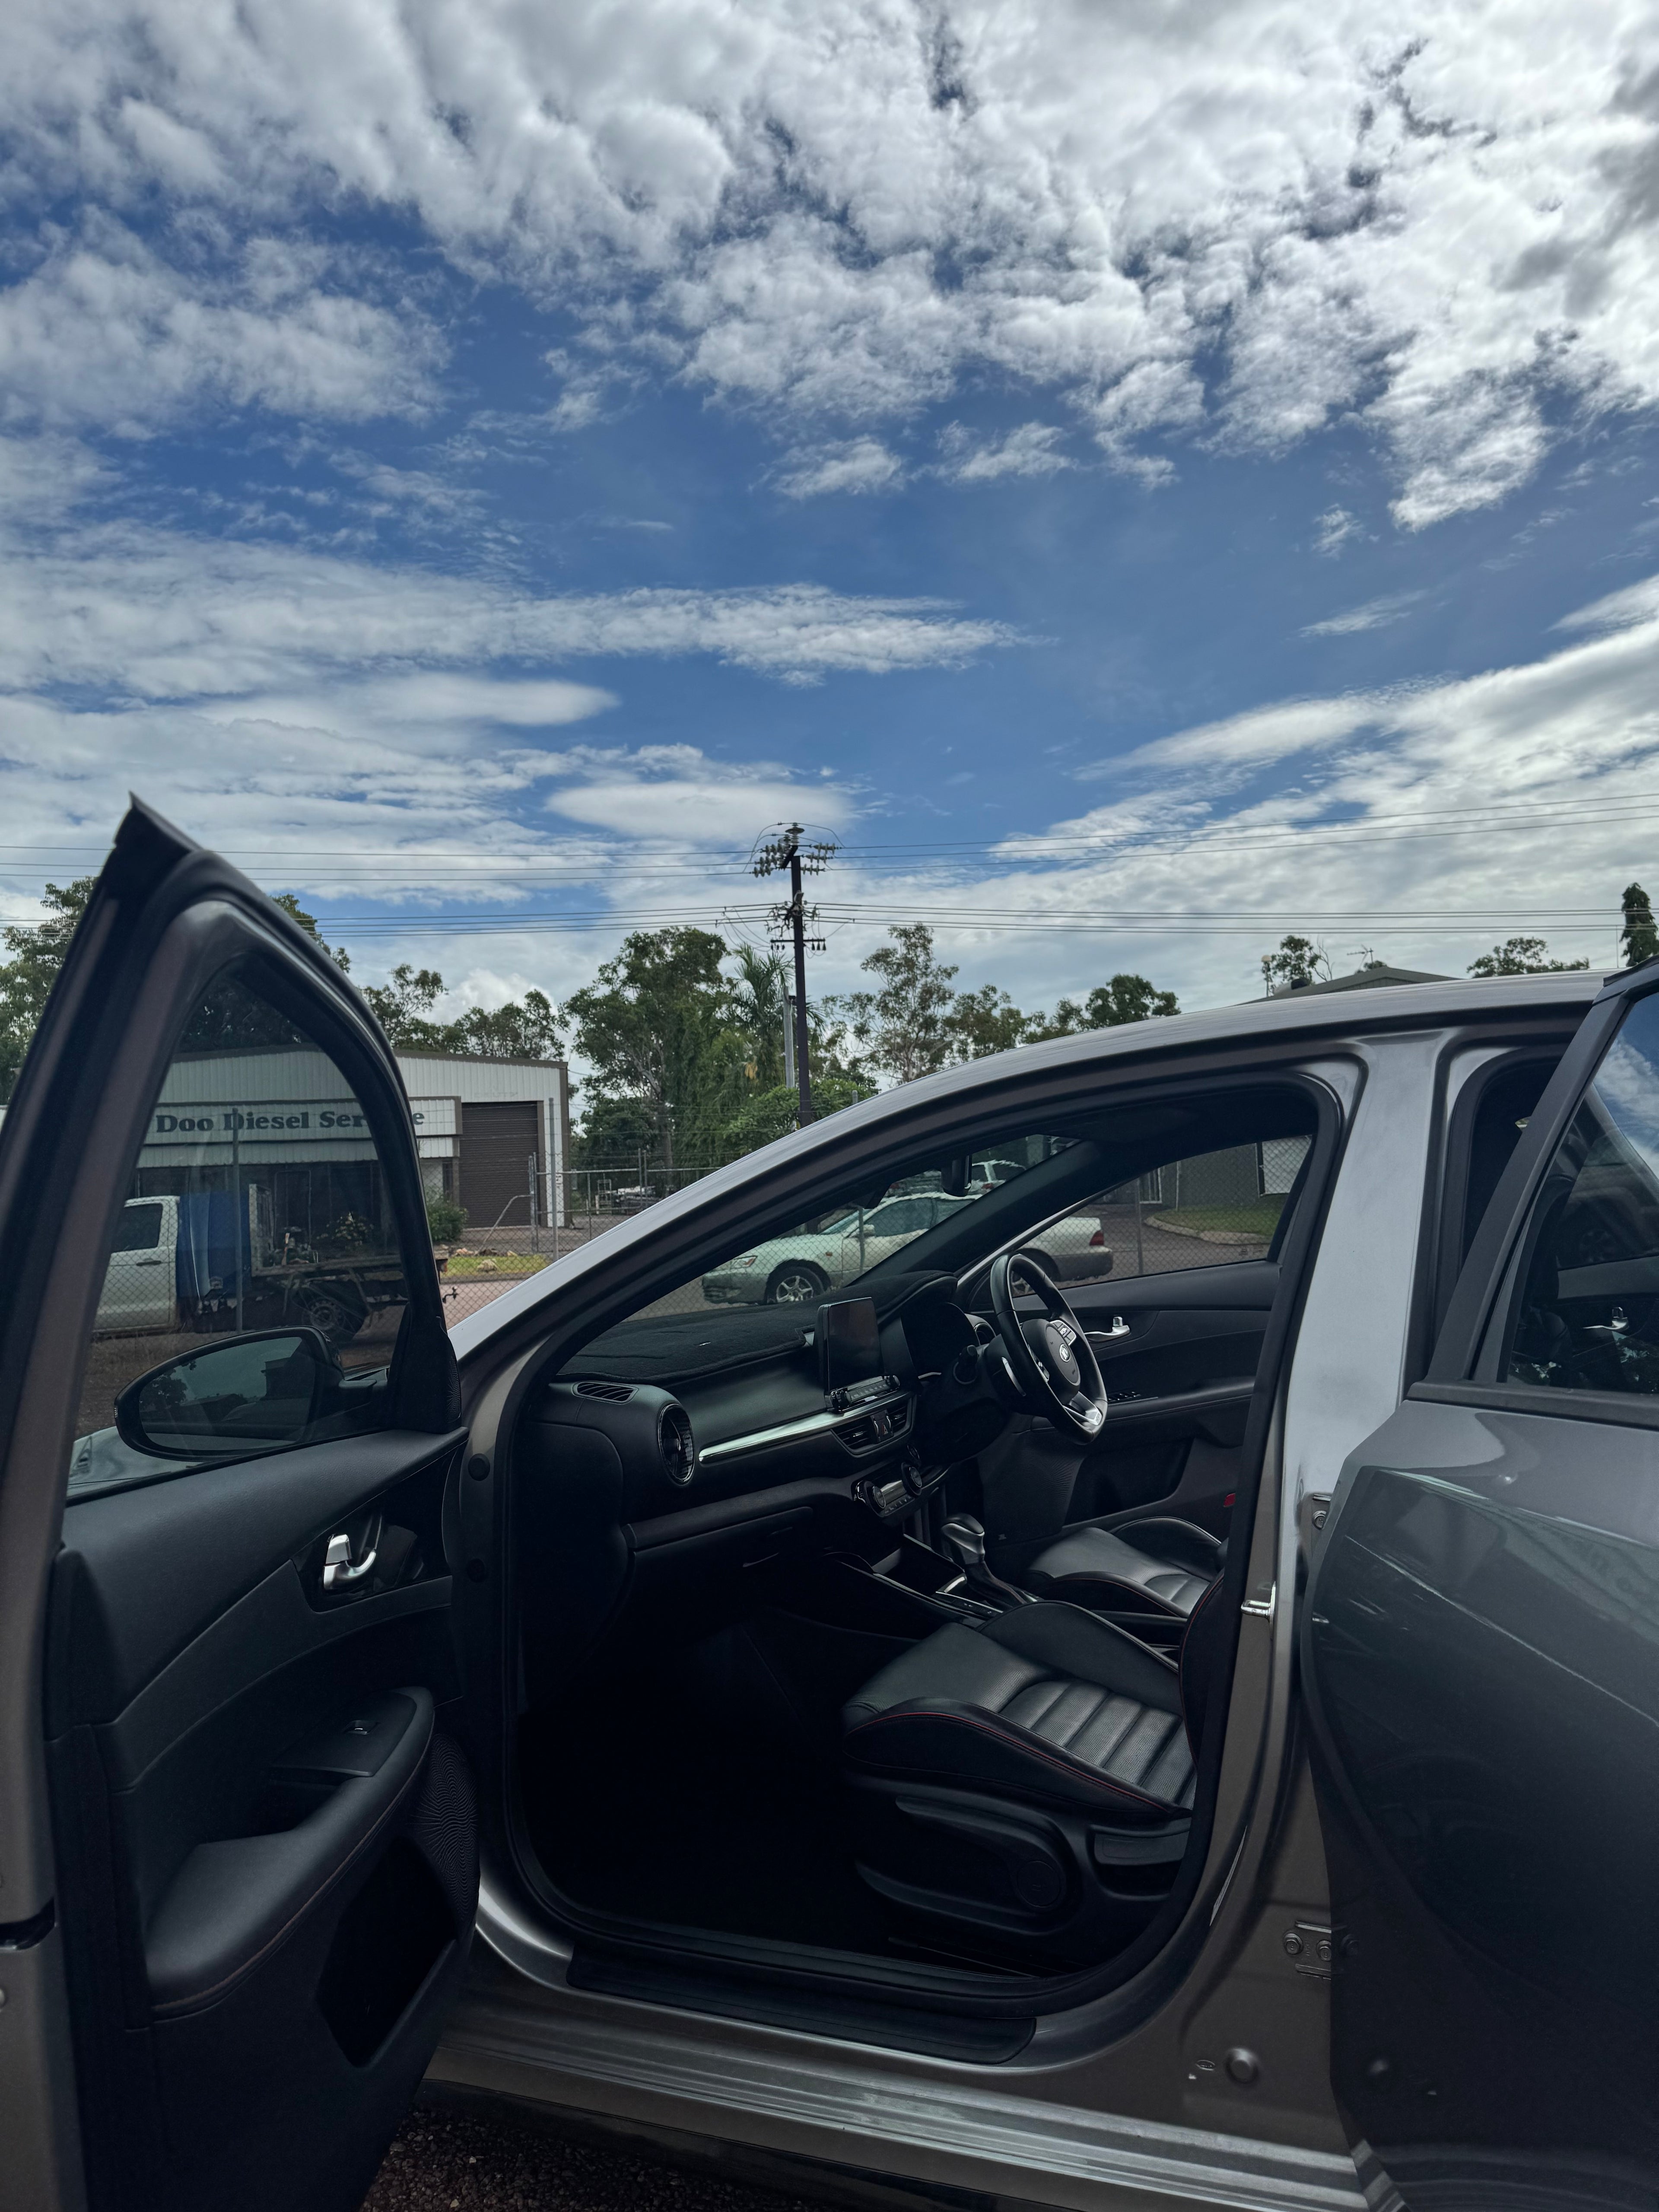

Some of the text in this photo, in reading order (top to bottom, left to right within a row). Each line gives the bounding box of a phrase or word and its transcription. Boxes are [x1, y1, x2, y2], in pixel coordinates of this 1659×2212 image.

[156, 1111, 425, 1132] Doo Diesel Sere
